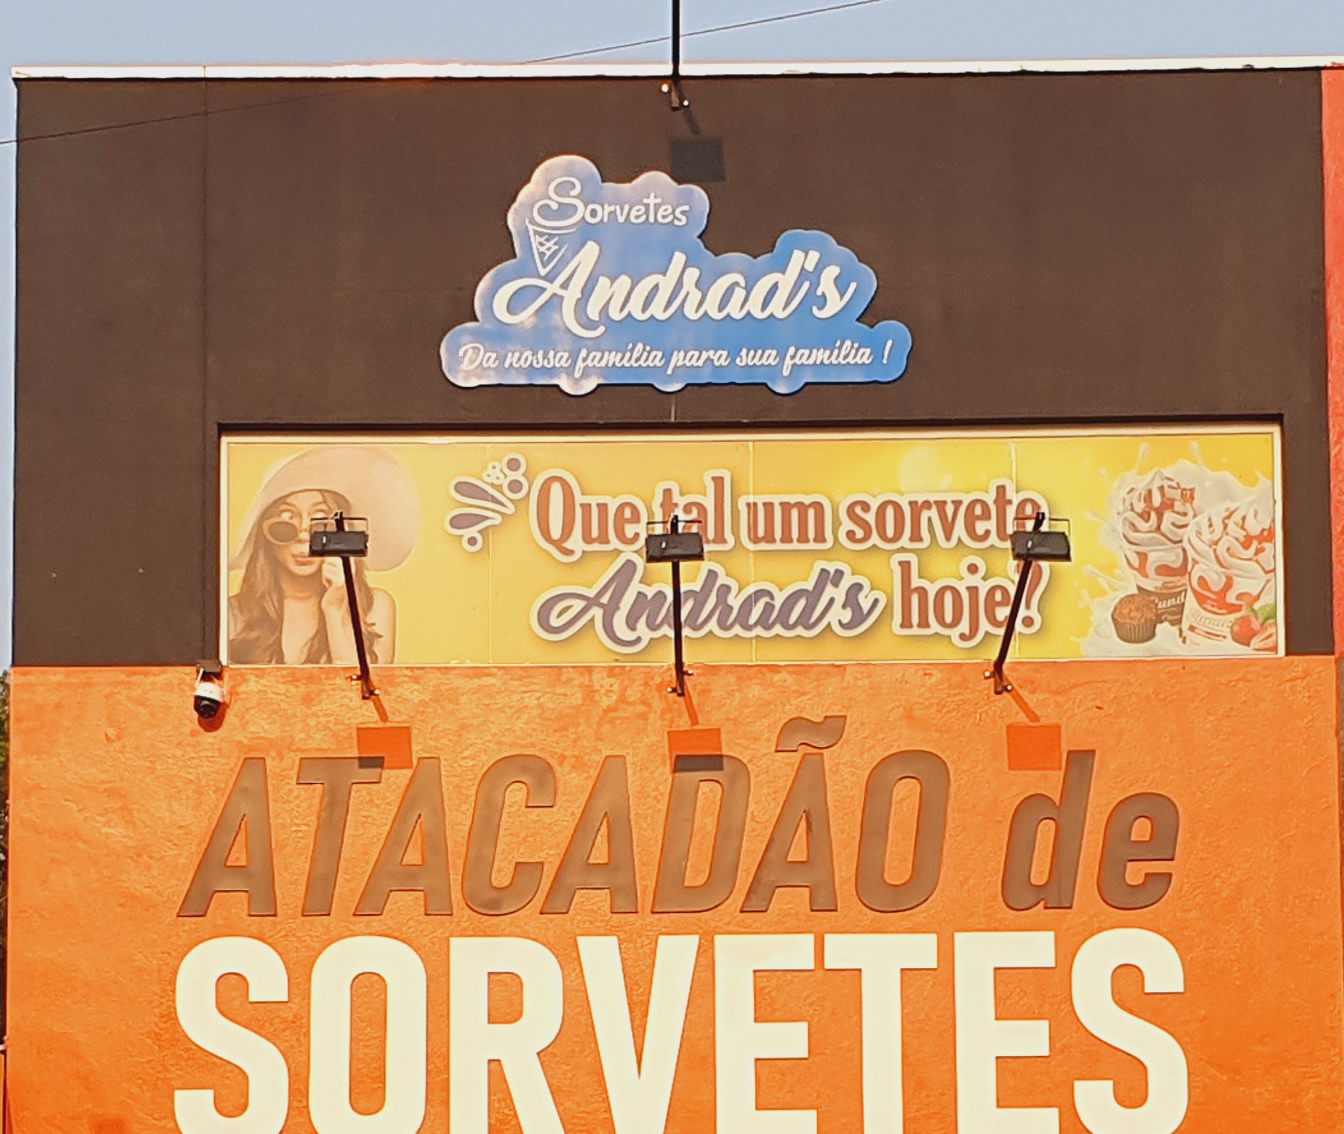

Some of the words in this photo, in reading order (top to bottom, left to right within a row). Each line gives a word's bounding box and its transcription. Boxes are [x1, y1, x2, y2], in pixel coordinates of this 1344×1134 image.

[532, 175, 690, 228] Sorvetes
[492, 240, 857, 338] Andrad's
[459, 343, 498, 370] Da
[504, 349, 570, 369] nossa
[574, 341, 665, 378] família
[666, 349, 730, 375] para
[735, 348, 778, 368] sua
[782, 340, 874, 377] família
[536, 474, 641, 556] Que
[745, 501, 829, 544] um
[844, 484, 1042, 545] sorvete
[536, 557, 879, 647] Andrad's
[176, 713, 952, 918] ATACADÃO
[999, 748, 1182, 913] de
